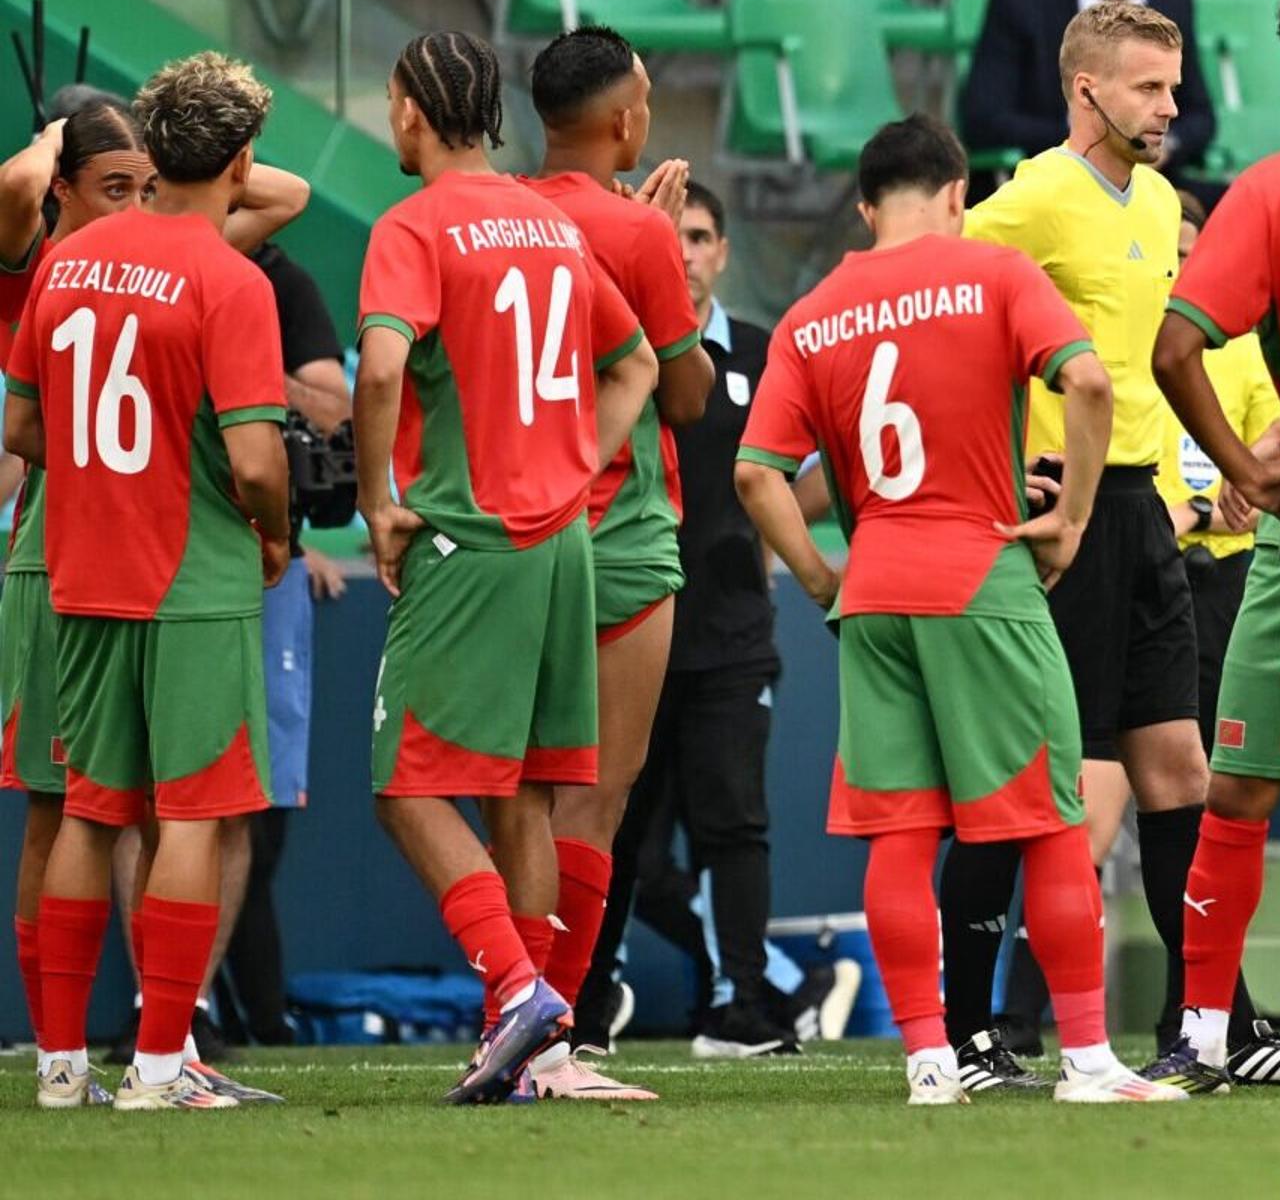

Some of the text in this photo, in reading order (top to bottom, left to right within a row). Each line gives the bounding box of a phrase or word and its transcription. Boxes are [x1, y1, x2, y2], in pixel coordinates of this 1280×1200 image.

[48, 259, 186, 305] EZZALZOULI
[494, 264, 580, 427] 14
[52, 306, 152, 475] 16
[859, 340, 926, 501] 6
